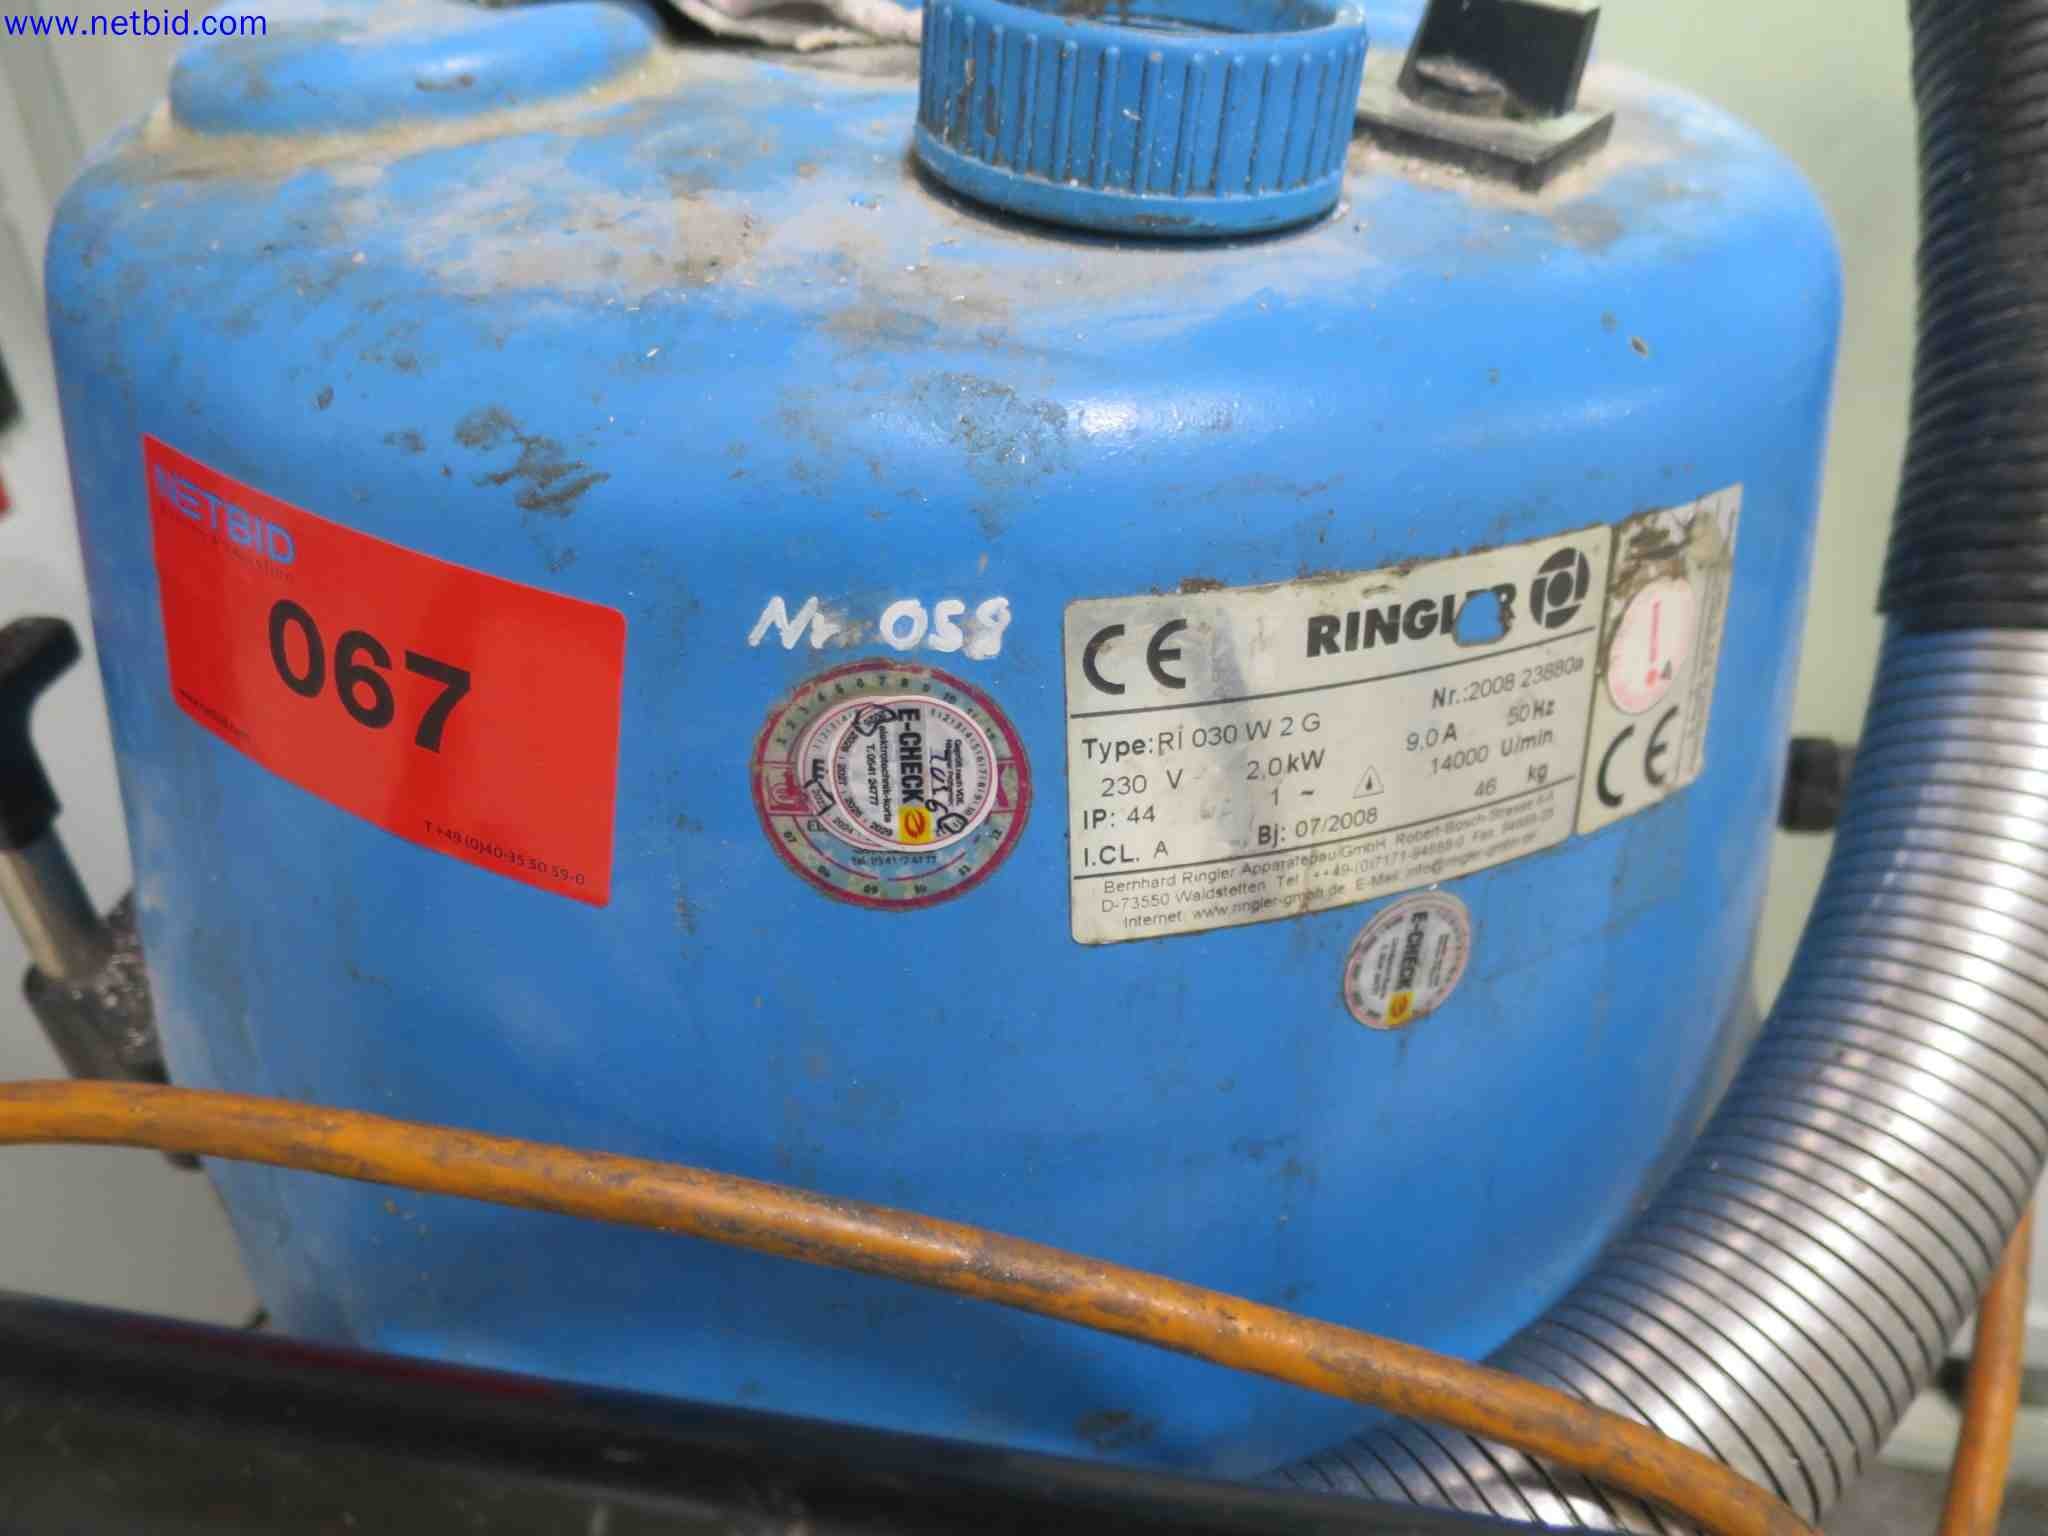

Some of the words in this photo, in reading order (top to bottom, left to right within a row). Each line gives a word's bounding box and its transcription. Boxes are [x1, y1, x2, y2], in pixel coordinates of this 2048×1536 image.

[1083, 619, 1187, 695] CE
[1306, 583, 1517, 657] RINGLR
[268, 599, 472, 754] 067
[897, 708, 925, 804] E-CHECK
[1082, 737, 1153, 764] Type:
[1192, 724, 1238, 748] 030
[1596, 704, 1680, 808] CE
[1083, 808, 1115, 831] IP:
[1127, 804, 1156, 825] 44
[1430, 744, 1490, 775] 14000
[1101, 774, 1148, 798] 230
[1166, 768, 1184, 790] V
[1153, 840, 1169, 859] A
[1295, 805, 1379, 839] 07/2008
[1473, 777, 1498, 798] 46
[1101, 892, 1170, 913] D-73550
[1103, 874, 1177, 895] Bernhard
[1182, 867, 1235, 885] Ringler
